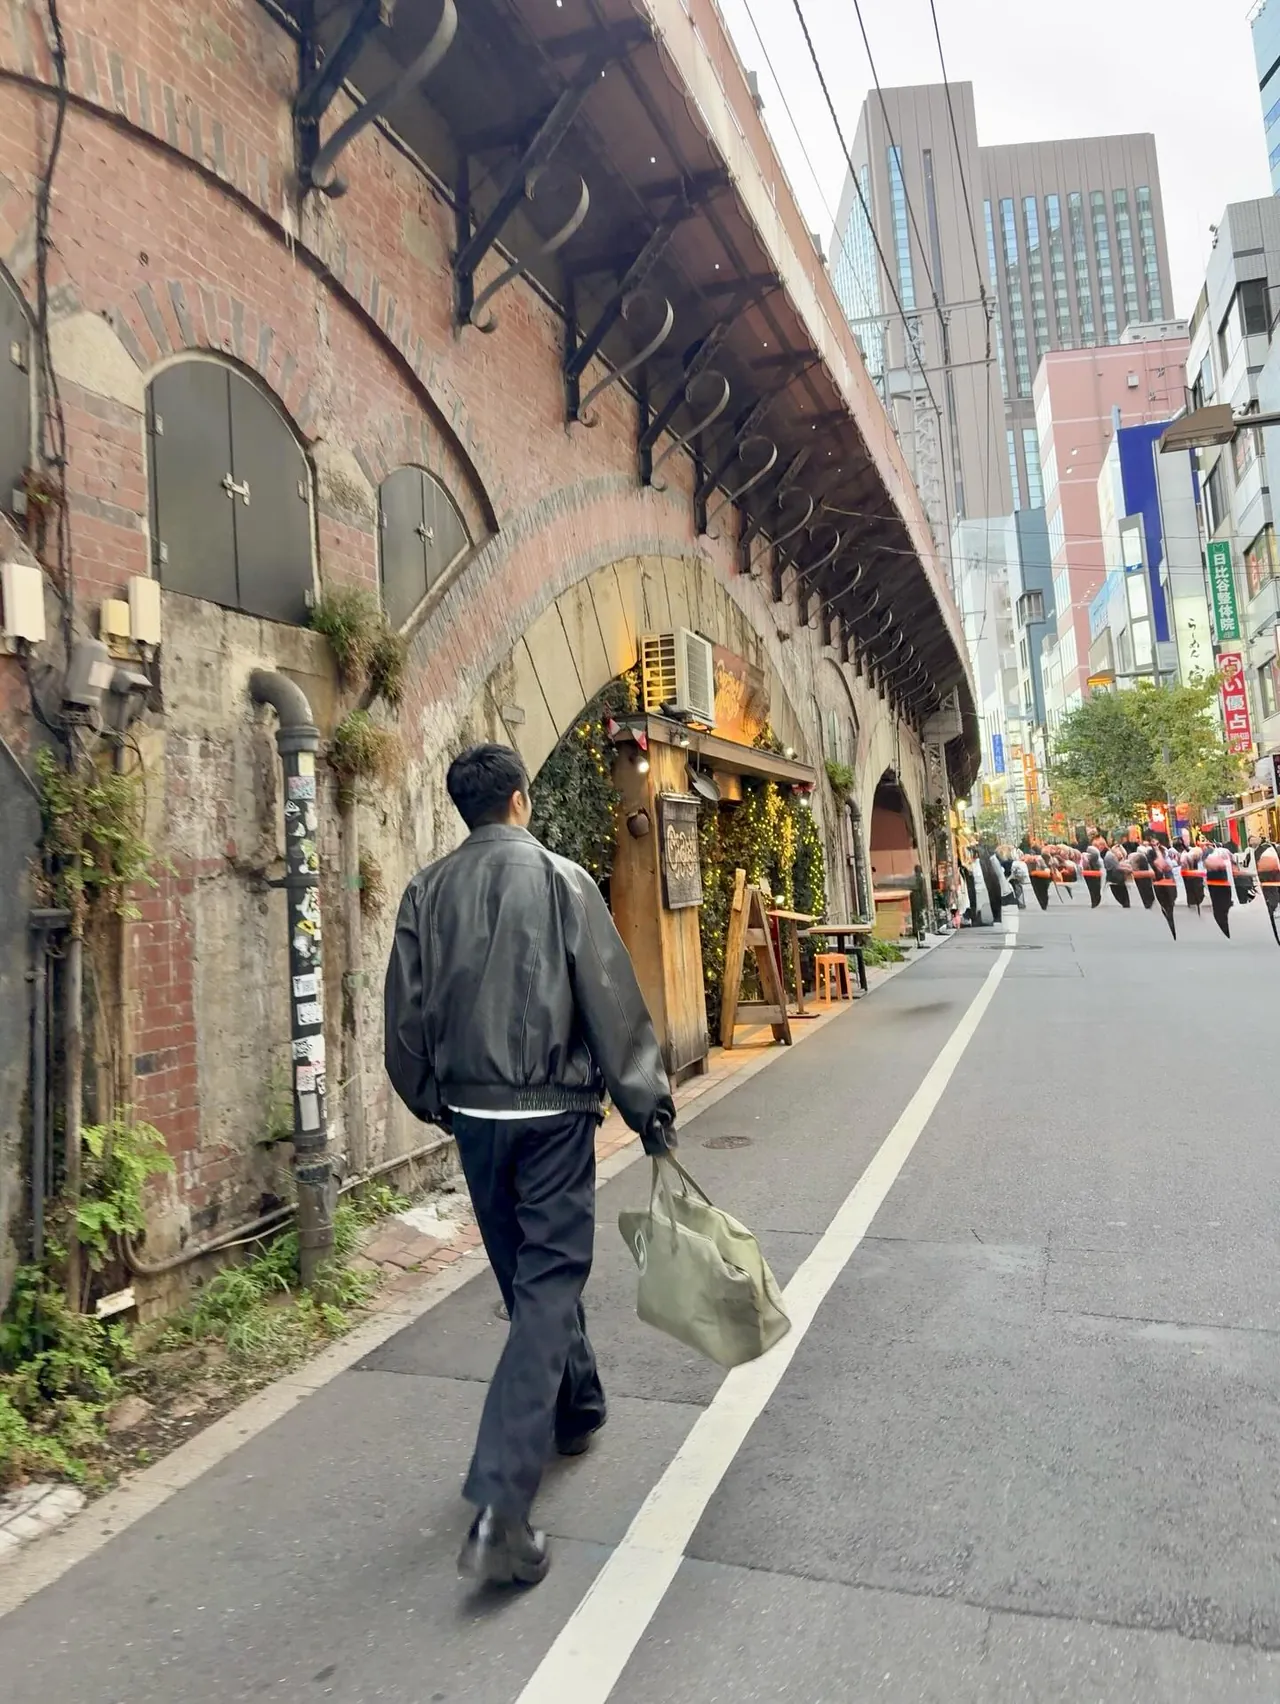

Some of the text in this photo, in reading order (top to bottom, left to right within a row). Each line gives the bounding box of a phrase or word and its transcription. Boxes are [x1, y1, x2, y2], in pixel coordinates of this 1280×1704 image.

[1213, 553, 1236, 631] 日比谷整体院
[1187, 617, 1201, 659] らーめん
